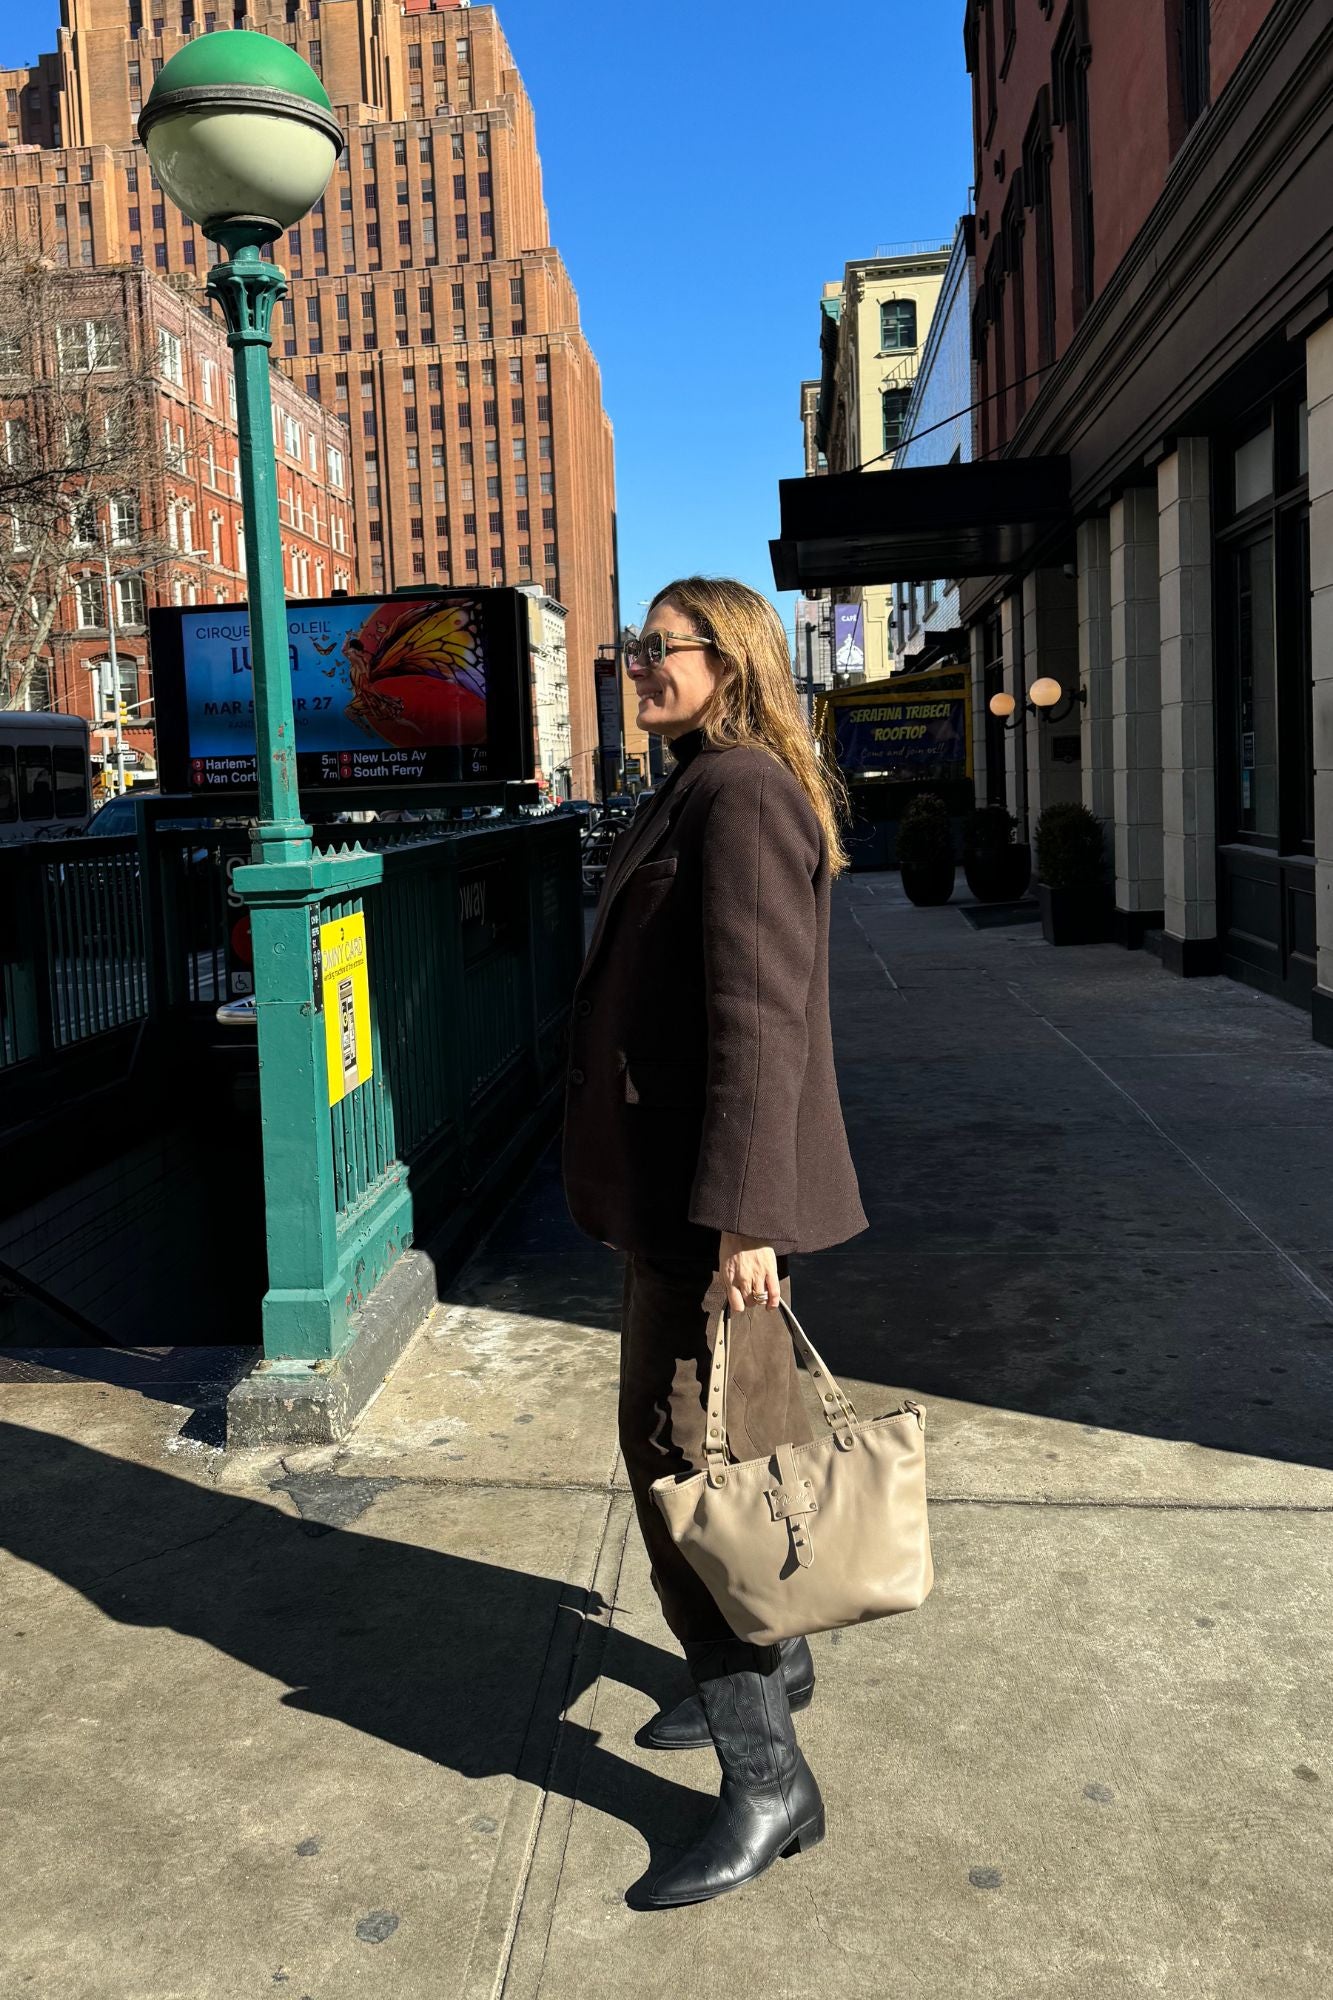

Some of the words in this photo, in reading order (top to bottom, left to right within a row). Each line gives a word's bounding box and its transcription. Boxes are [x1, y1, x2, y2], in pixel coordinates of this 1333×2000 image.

[196, 625, 250, 641] CIRQUE
[288, 621, 331, 634] OLEIL
[204, 701, 242, 715] MAR
[312, 697, 333, 710] 27
[850, 707, 903, 723] SERAFINA
[906, 704, 951, 720] TRIBECA
[874, 725, 927, 741] ROOFTOP
[321, 755, 336, 765] 5m
[353, 752, 378, 764] New
[381, 751, 408, 762] Lots
[411, 750, 427, 761] Av
[471, 748, 487, 758] 7m
[887, 747, 904, 757] and
[206, 773, 228, 784] Van
[322, 769, 338, 779] 7m
[353, 765, 389, 778] South
[392, 765, 423, 777] Ferry
[472, 762, 488, 772] 9m
[458, 879, 487, 926] way
[345, 936, 363, 962] CARD
